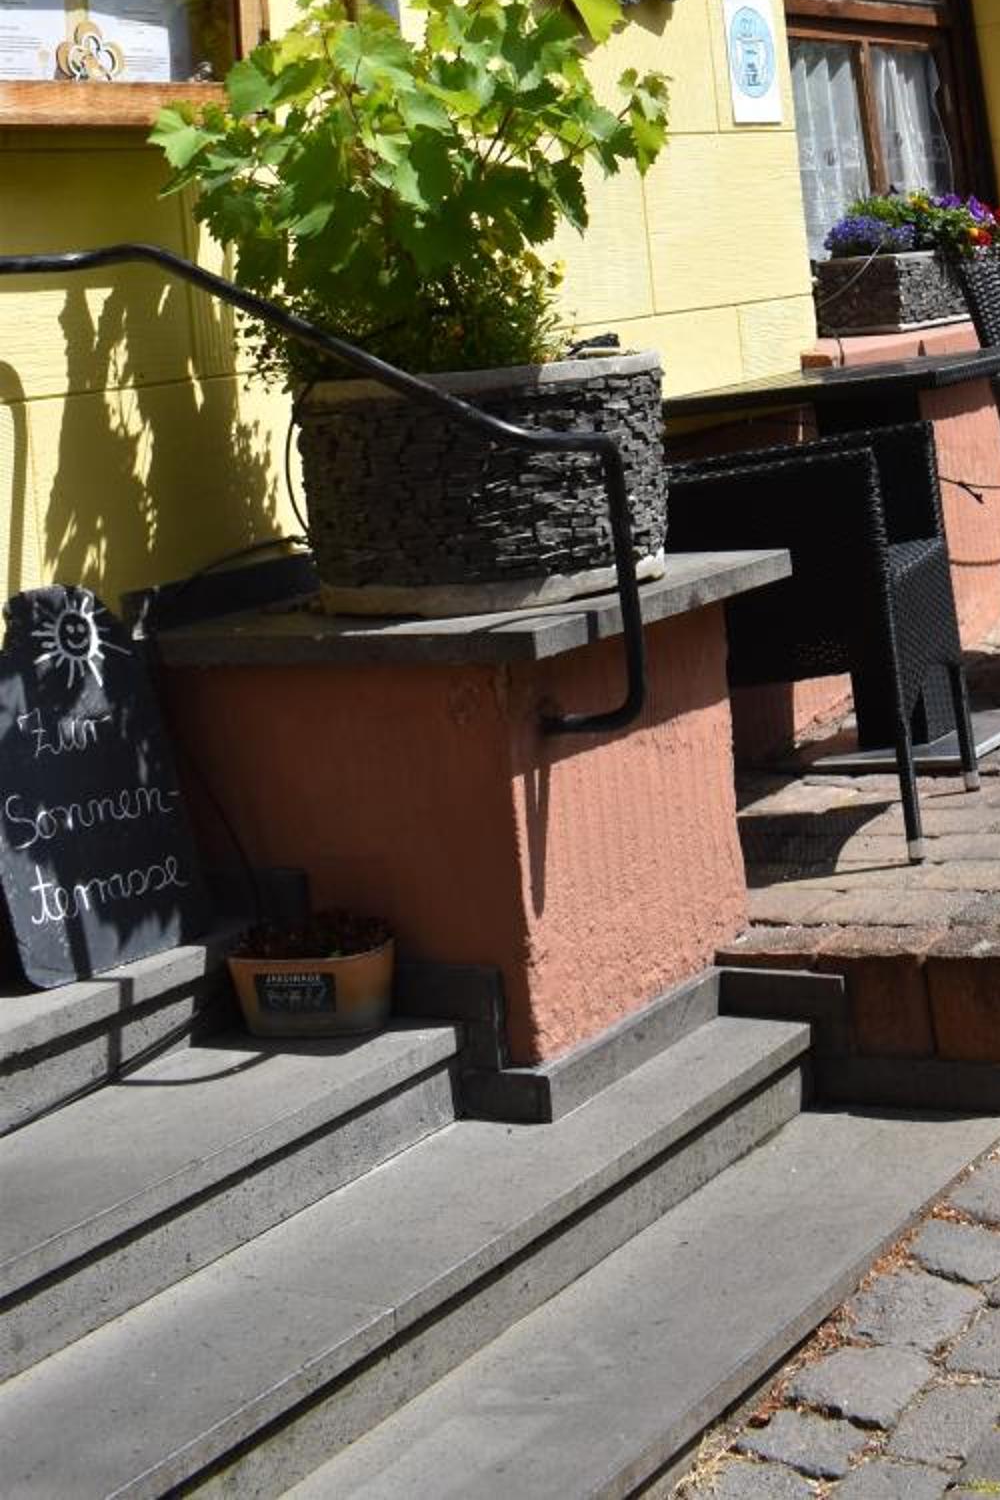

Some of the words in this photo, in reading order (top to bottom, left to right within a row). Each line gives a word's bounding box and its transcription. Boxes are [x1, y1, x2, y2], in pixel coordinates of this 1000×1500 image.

[17, 708, 112, 759] Zur
[5, 787, 180, 850] Sonnen-
[31, 856, 190, 924] terrasse
